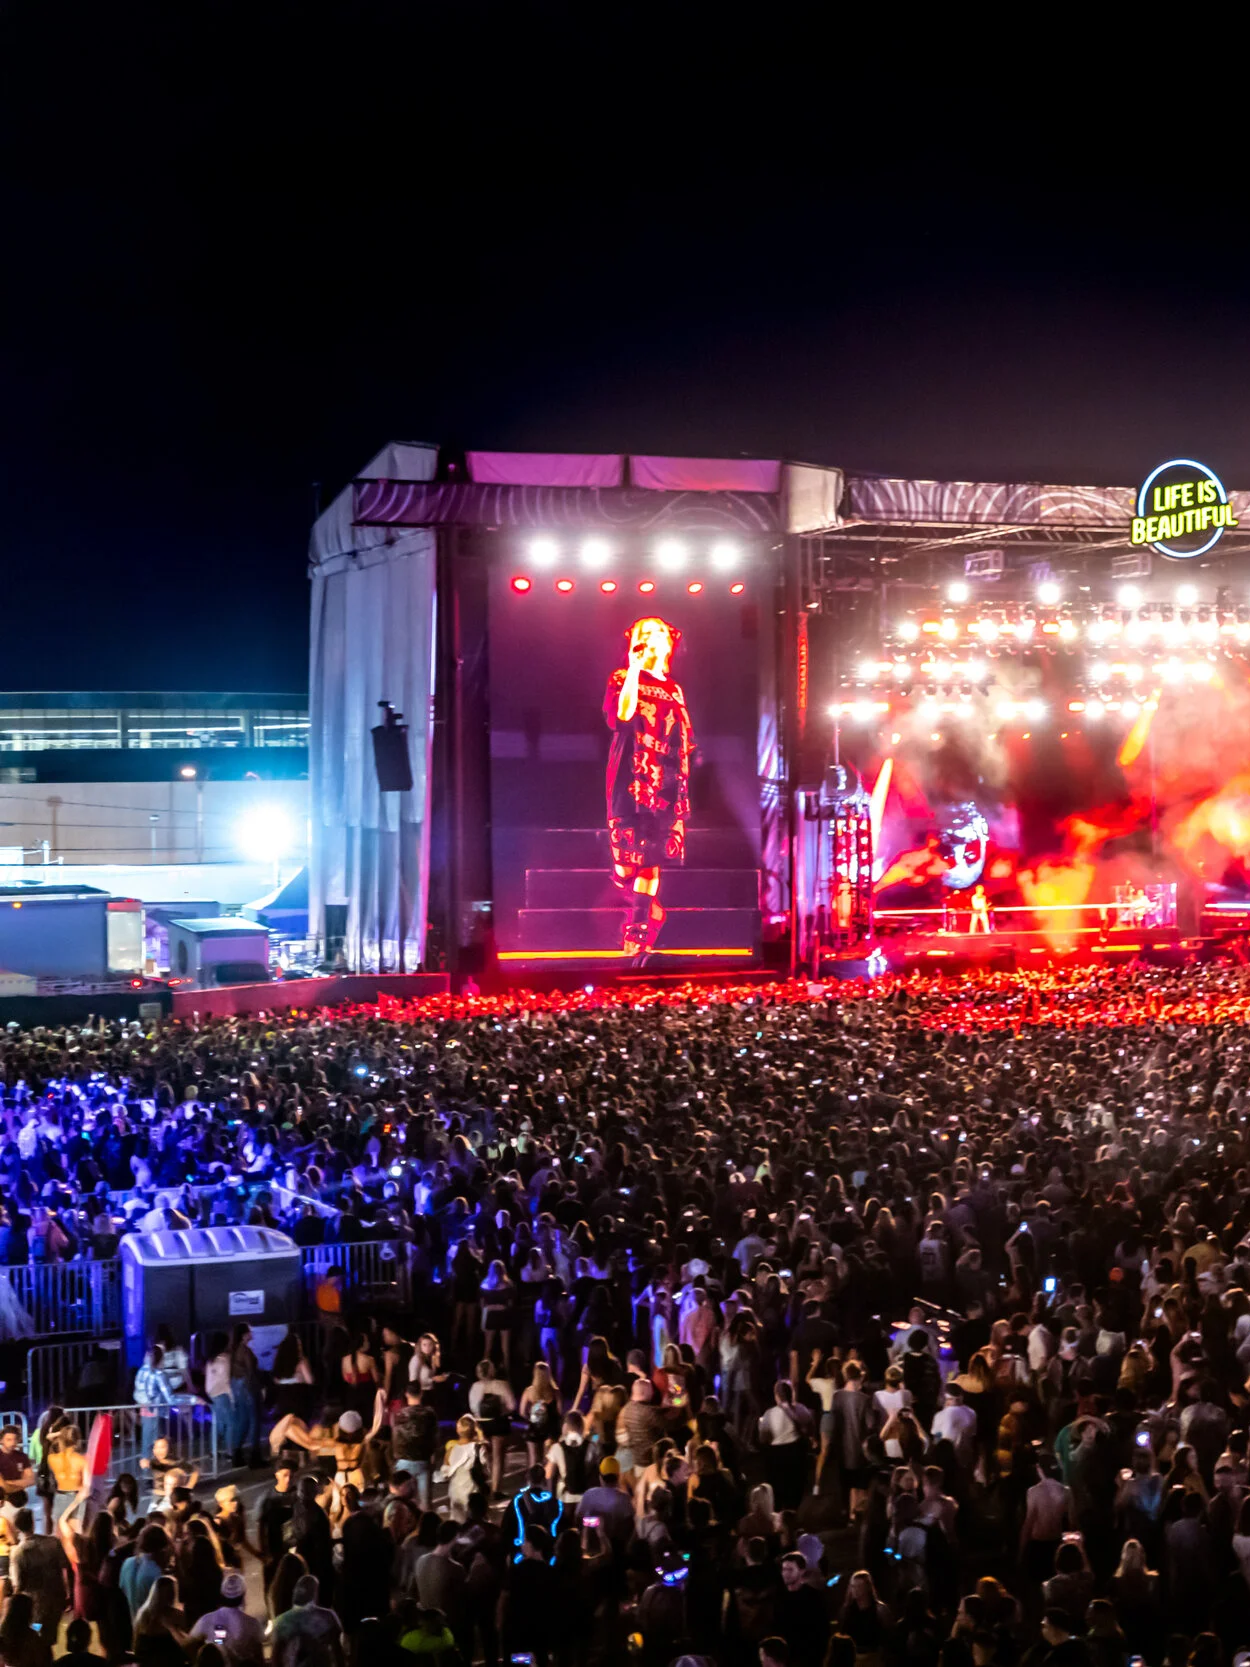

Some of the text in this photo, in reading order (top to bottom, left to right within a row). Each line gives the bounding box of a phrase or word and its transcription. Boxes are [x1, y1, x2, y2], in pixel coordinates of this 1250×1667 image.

[1154, 480, 1217, 511] LIFE IS
[1132, 504, 1238, 544] BEAUTIFUL
